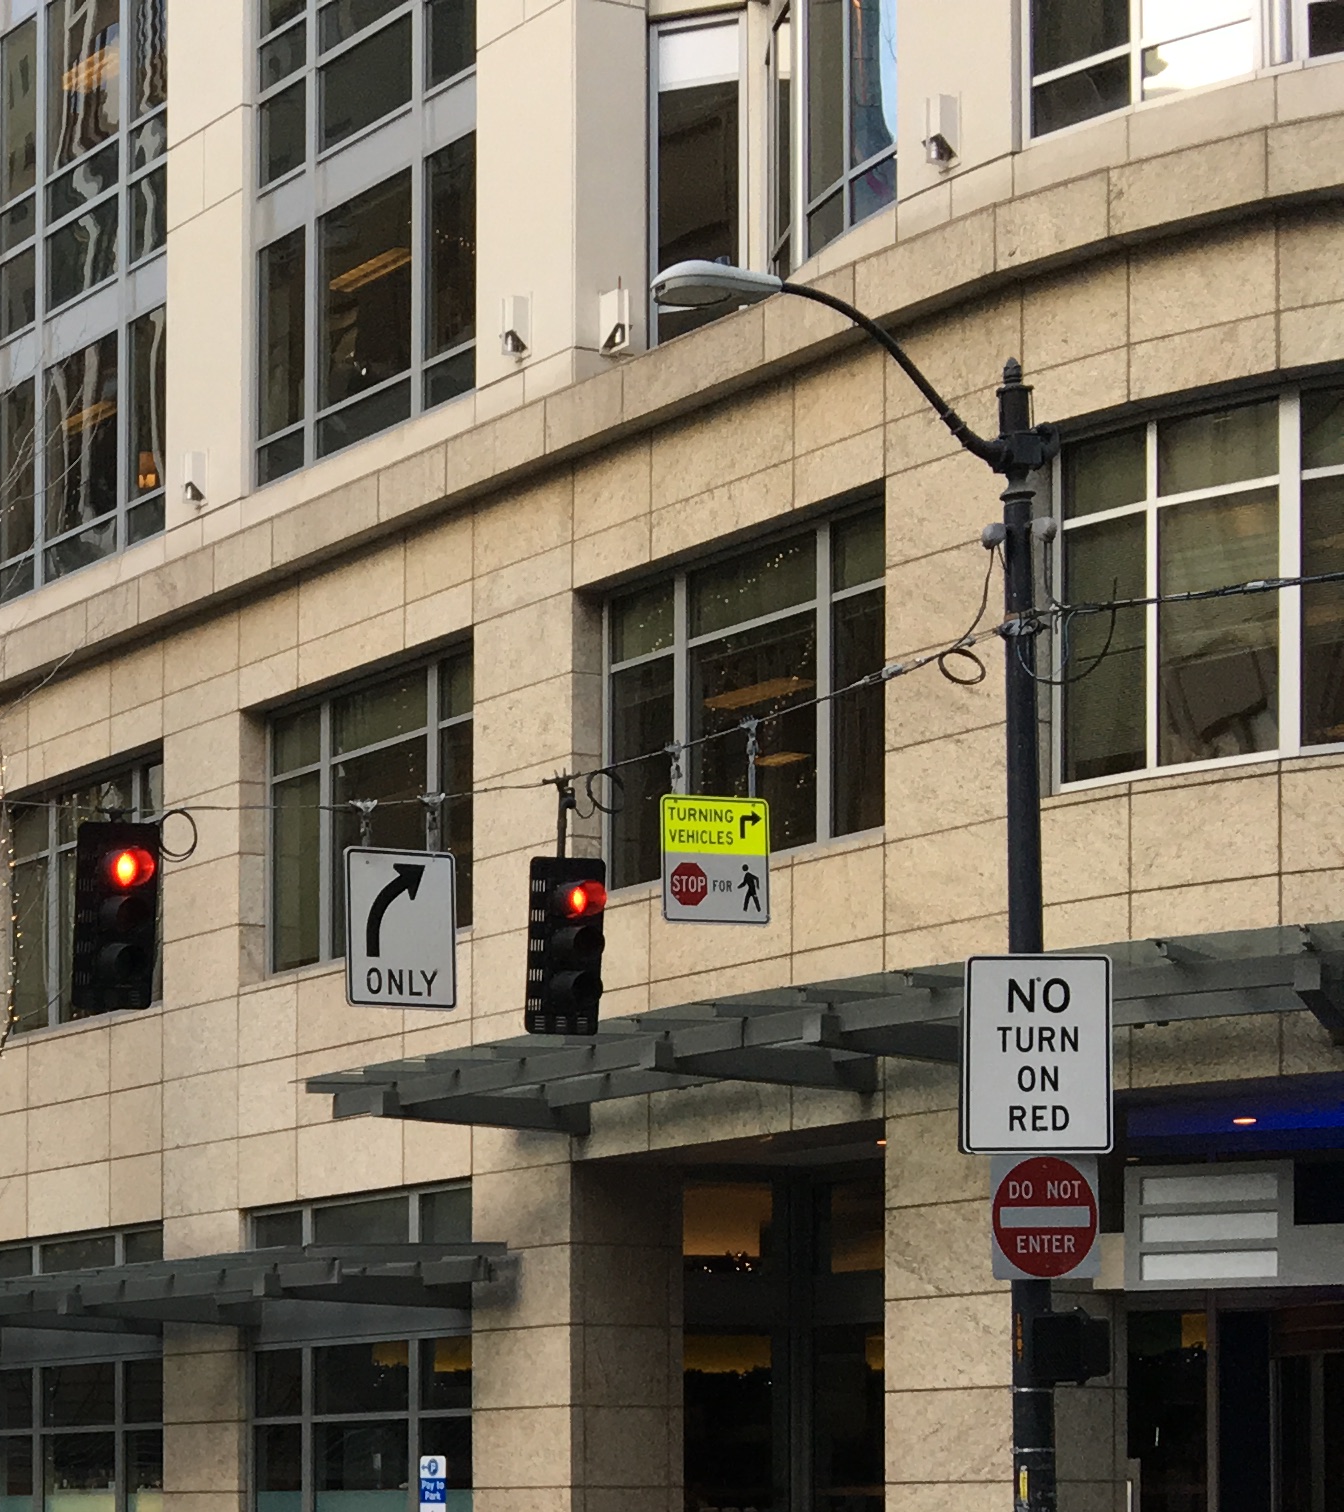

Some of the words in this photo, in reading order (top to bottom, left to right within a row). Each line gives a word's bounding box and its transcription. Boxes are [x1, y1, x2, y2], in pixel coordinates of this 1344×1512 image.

[668, 807, 734, 824] TURNING
[668, 829, 734, 846] VEHICLES
[672, 875, 706, 893] STOP
[712, 879, 733, 893] FOR
[366, 967, 438, 997] ONLY
[1007, 977, 1071, 1014] NO
[997, 1026, 1079, 1053] TURN
[1017, 1065, 1060, 1093] ON
[1008, 1105, 1070, 1132] RED
[1008, 1181, 1033, 1200] DO
[1047, 1181, 1081, 1199] NOT
[1016, 1235, 1076, 1254] ENTER
[421, 1480, 435, 1491] Pay
[436, 1481, 445, 1490] to
[424, 1491, 442, 1501] Park
